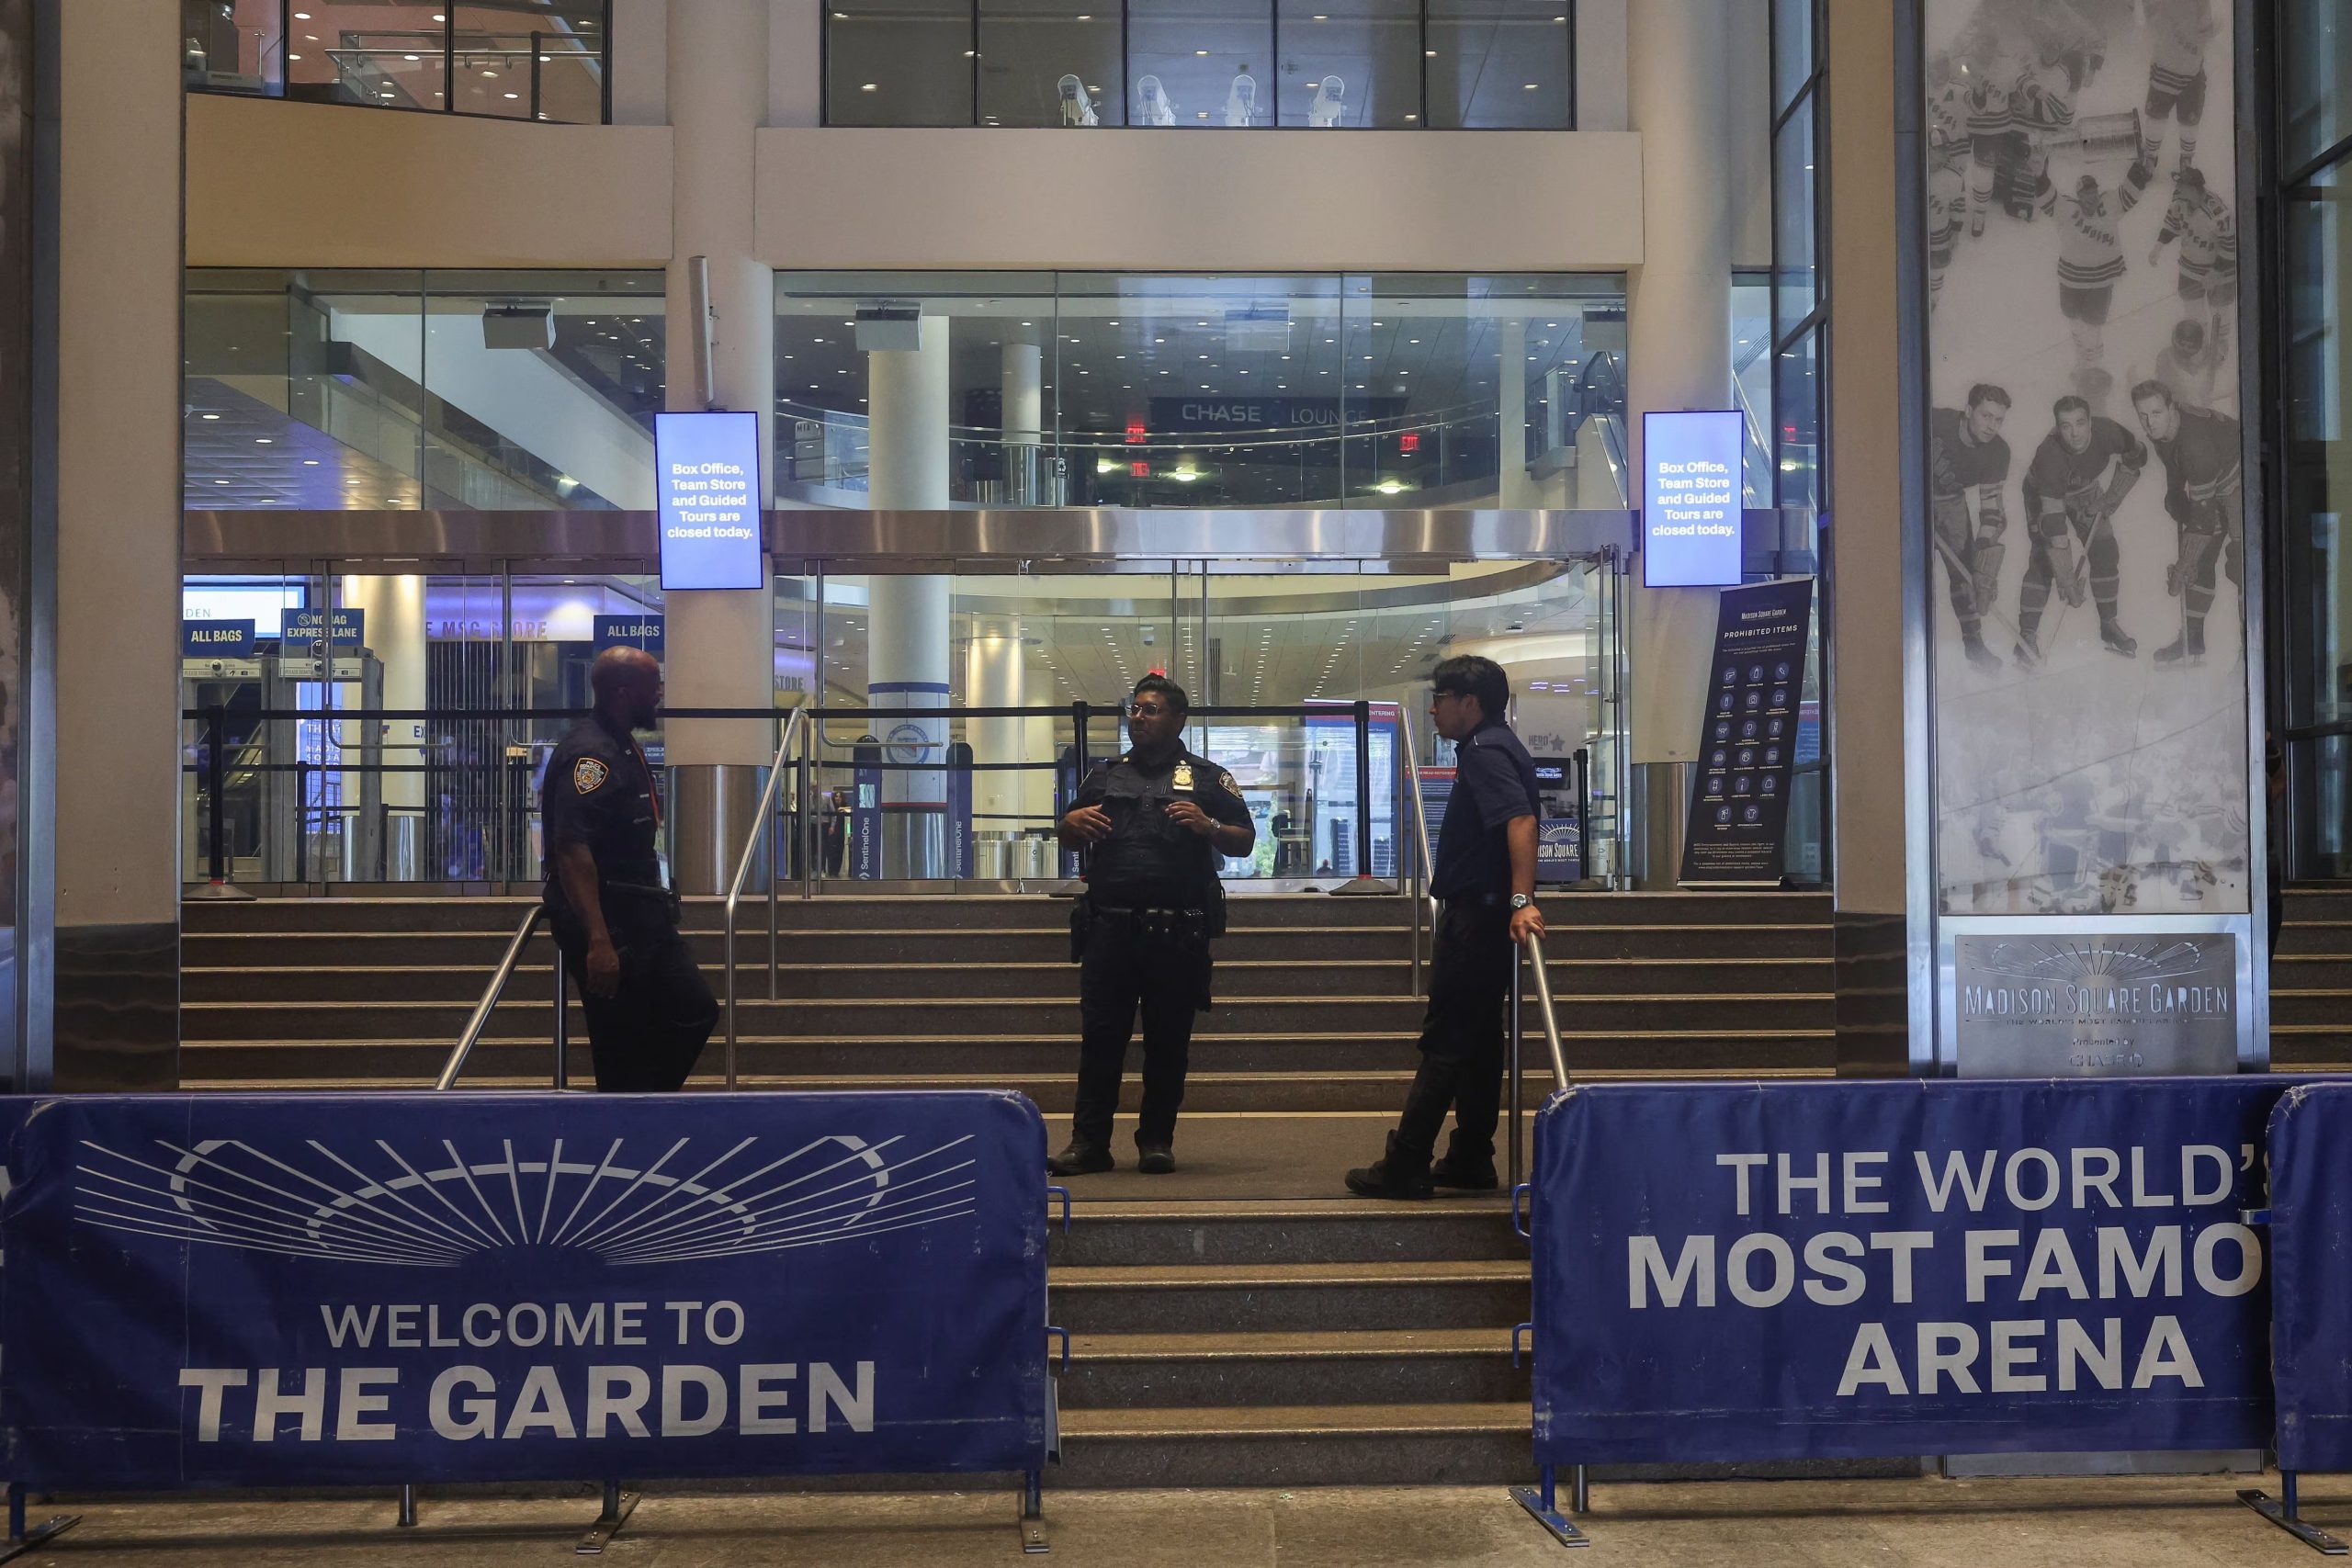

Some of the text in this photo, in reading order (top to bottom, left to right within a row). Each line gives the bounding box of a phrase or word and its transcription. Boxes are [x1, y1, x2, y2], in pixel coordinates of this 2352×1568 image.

[1182, 403, 1262, 423] CHASE
[672, 463, 744, 476] Box Office,
[1659, 461, 1728, 475] Box Office,
[672, 479, 746, 491] Team Store
[1657, 477, 1730, 489] Team Store
[672, 495, 747, 506] and Guided
[1657, 492, 1730, 505] and Guided
[679, 511, 741, 523] Tours are
[1664, 509, 1724, 520] Tours are
[667, 526, 753, 540] closed today.
[1652, 524, 1736, 537] closed today.
[186, 609, 210, 618] DEN
[191, 629, 243, 642] ALL BAGS
[288, 628, 357, 637] EXPRES LANE
[490, 621, 548, 640] SORE
[607, 626, 660, 637] ALL BAGS
[1724, 625, 1798, 639] PROHIBITED ITEMS
[775, 675, 804, 691] STORE
[1529, 735, 1549, 746] HERO
[860, 817, 870, 870] SentinelOne
[1555, 842, 1578, 858] SQUARE
[1965, 983, 2228, 1017] MADISON SQUARE GARDEN
[2123, 1037, 2134, 1047] by
[1716, 1144, 2271, 1215] THE WORLD'
[1628, 1231, 1934, 1309] MOST
[321, 1300, 745, 1348] WELCOME TO
[1837, 1315, 2204, 1396] ARENA
[179, 1360, 875, 1441] THE GARDEN
